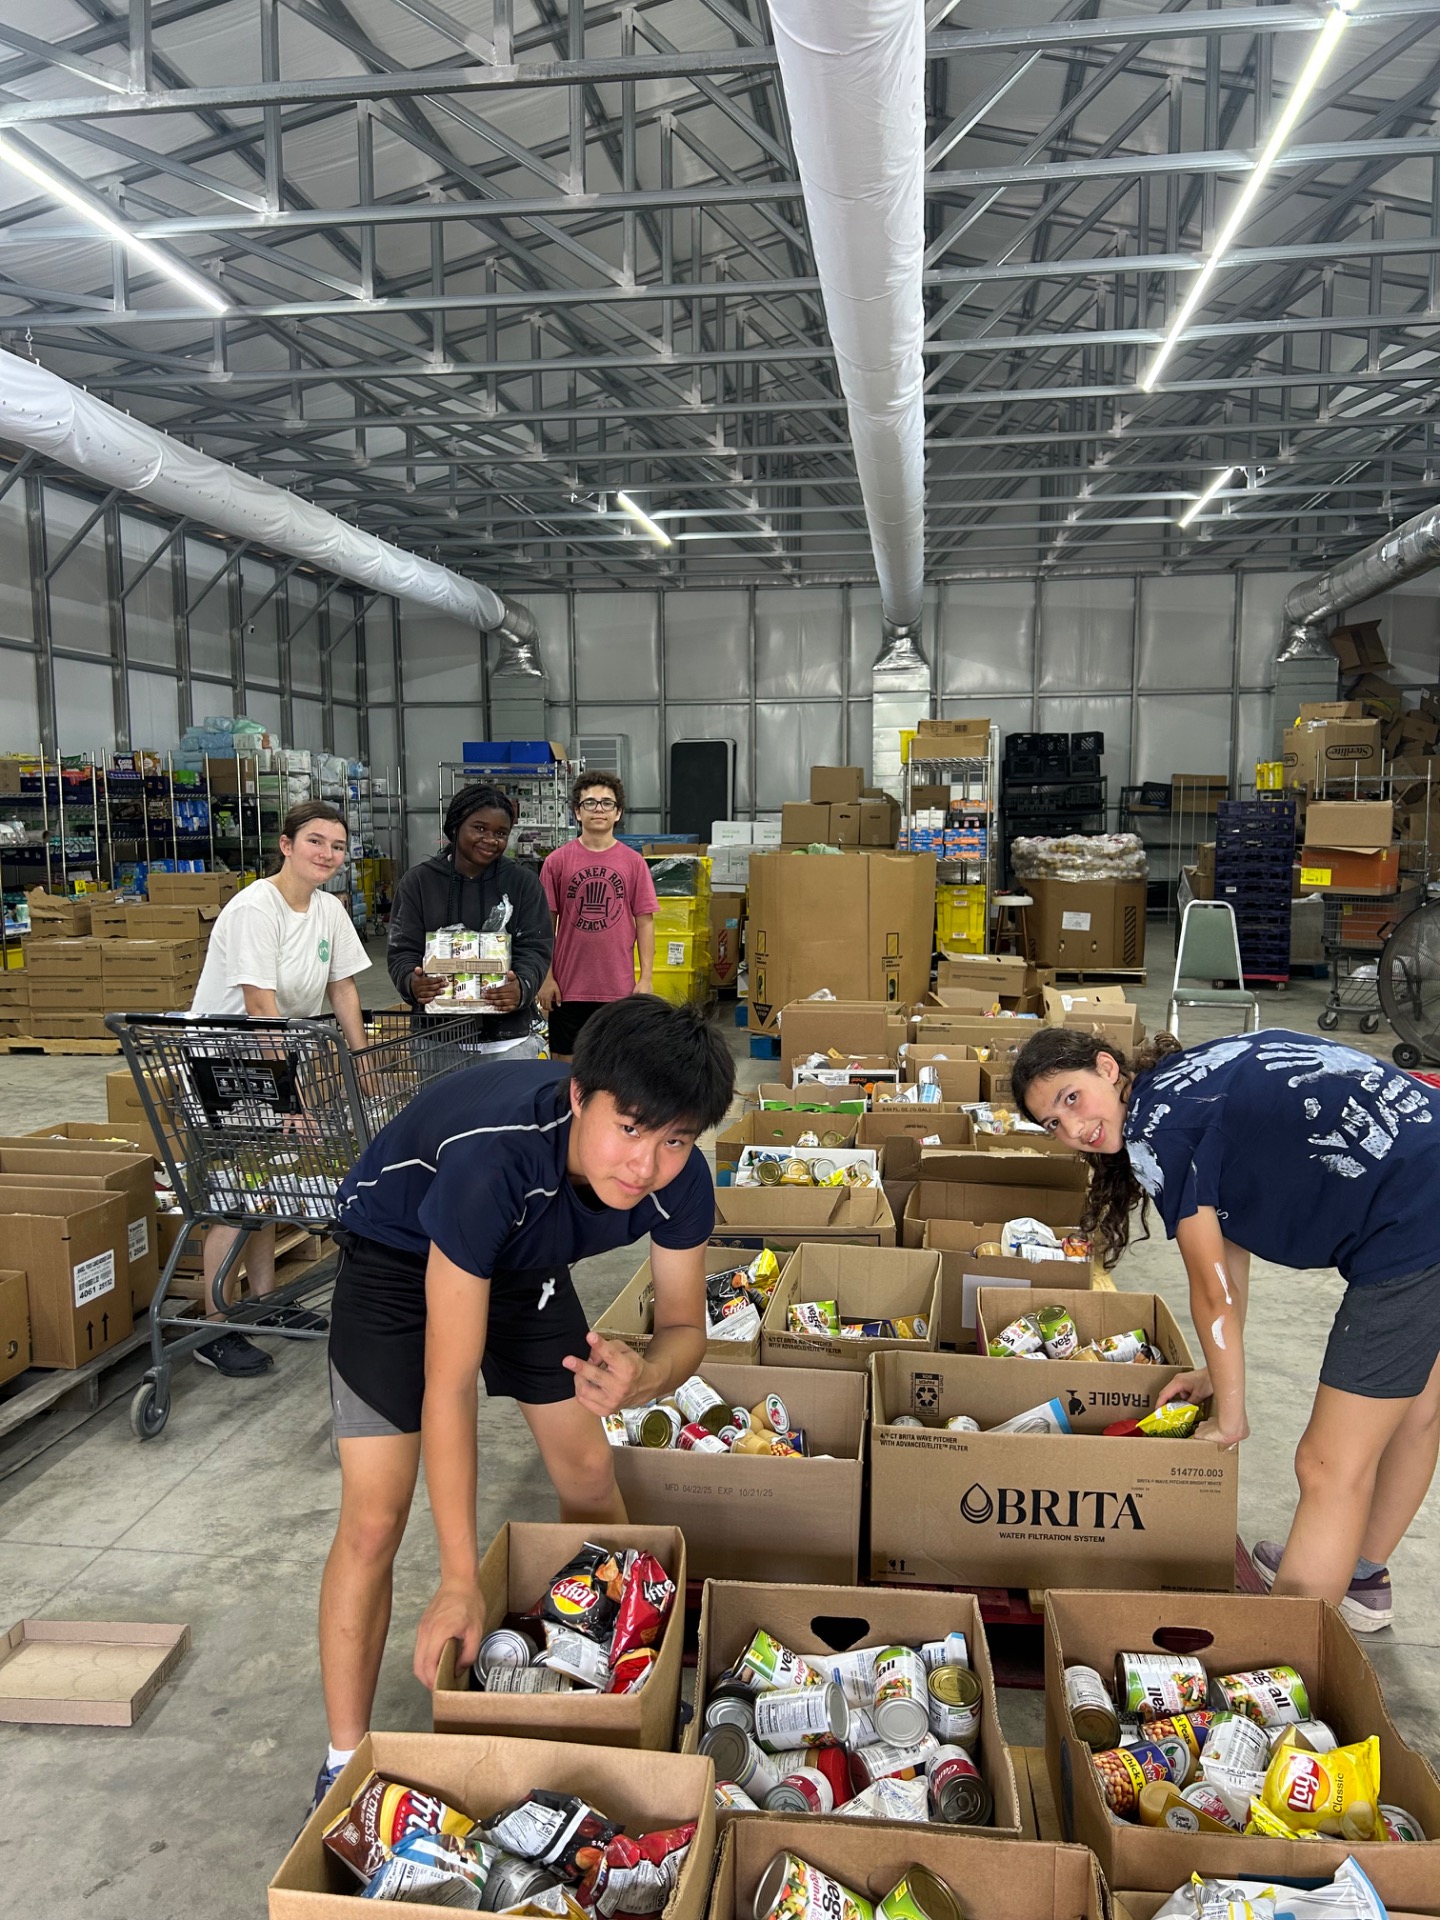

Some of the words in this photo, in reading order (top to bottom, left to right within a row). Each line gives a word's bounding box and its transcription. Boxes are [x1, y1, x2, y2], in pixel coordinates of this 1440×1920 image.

[566, 867, 607, 899] BREAKER
[608, 872, 624, 899] ROCK
[576, 918, 608, 931] BEACH
[1088, 1391, 1150, 1408] FRAGILE
[898, 1433, 915, 1441] BRITA
[916, 1434, 932, 1442] WAVE
[933, 1436, 958, 1444] PITCHER
[1170, 1467, 1224, 1478] 514770.003
[664, 1482, 679, 1492] MFD
[682, 1485, 712, 1494] 04/22/25
[718, 1486, 734, 1495] EXP
[999, 1532, 1026, 1540] WATER
[1028, 1533, 1072, 1542] FILTRATION
[1073, 1534, 1105, 1543] SYSTEM
[1178, 1722, 1193, 1746] Peas
[1122, 1753, 1141, 1780] Chick
[1332, 1772, 1345, 1813] Classic
[364, 1800, 378, 1844] CHEESE
[396, 1806, 406, 1838] BRAND
[406, 1864, 415, 1880] 150
